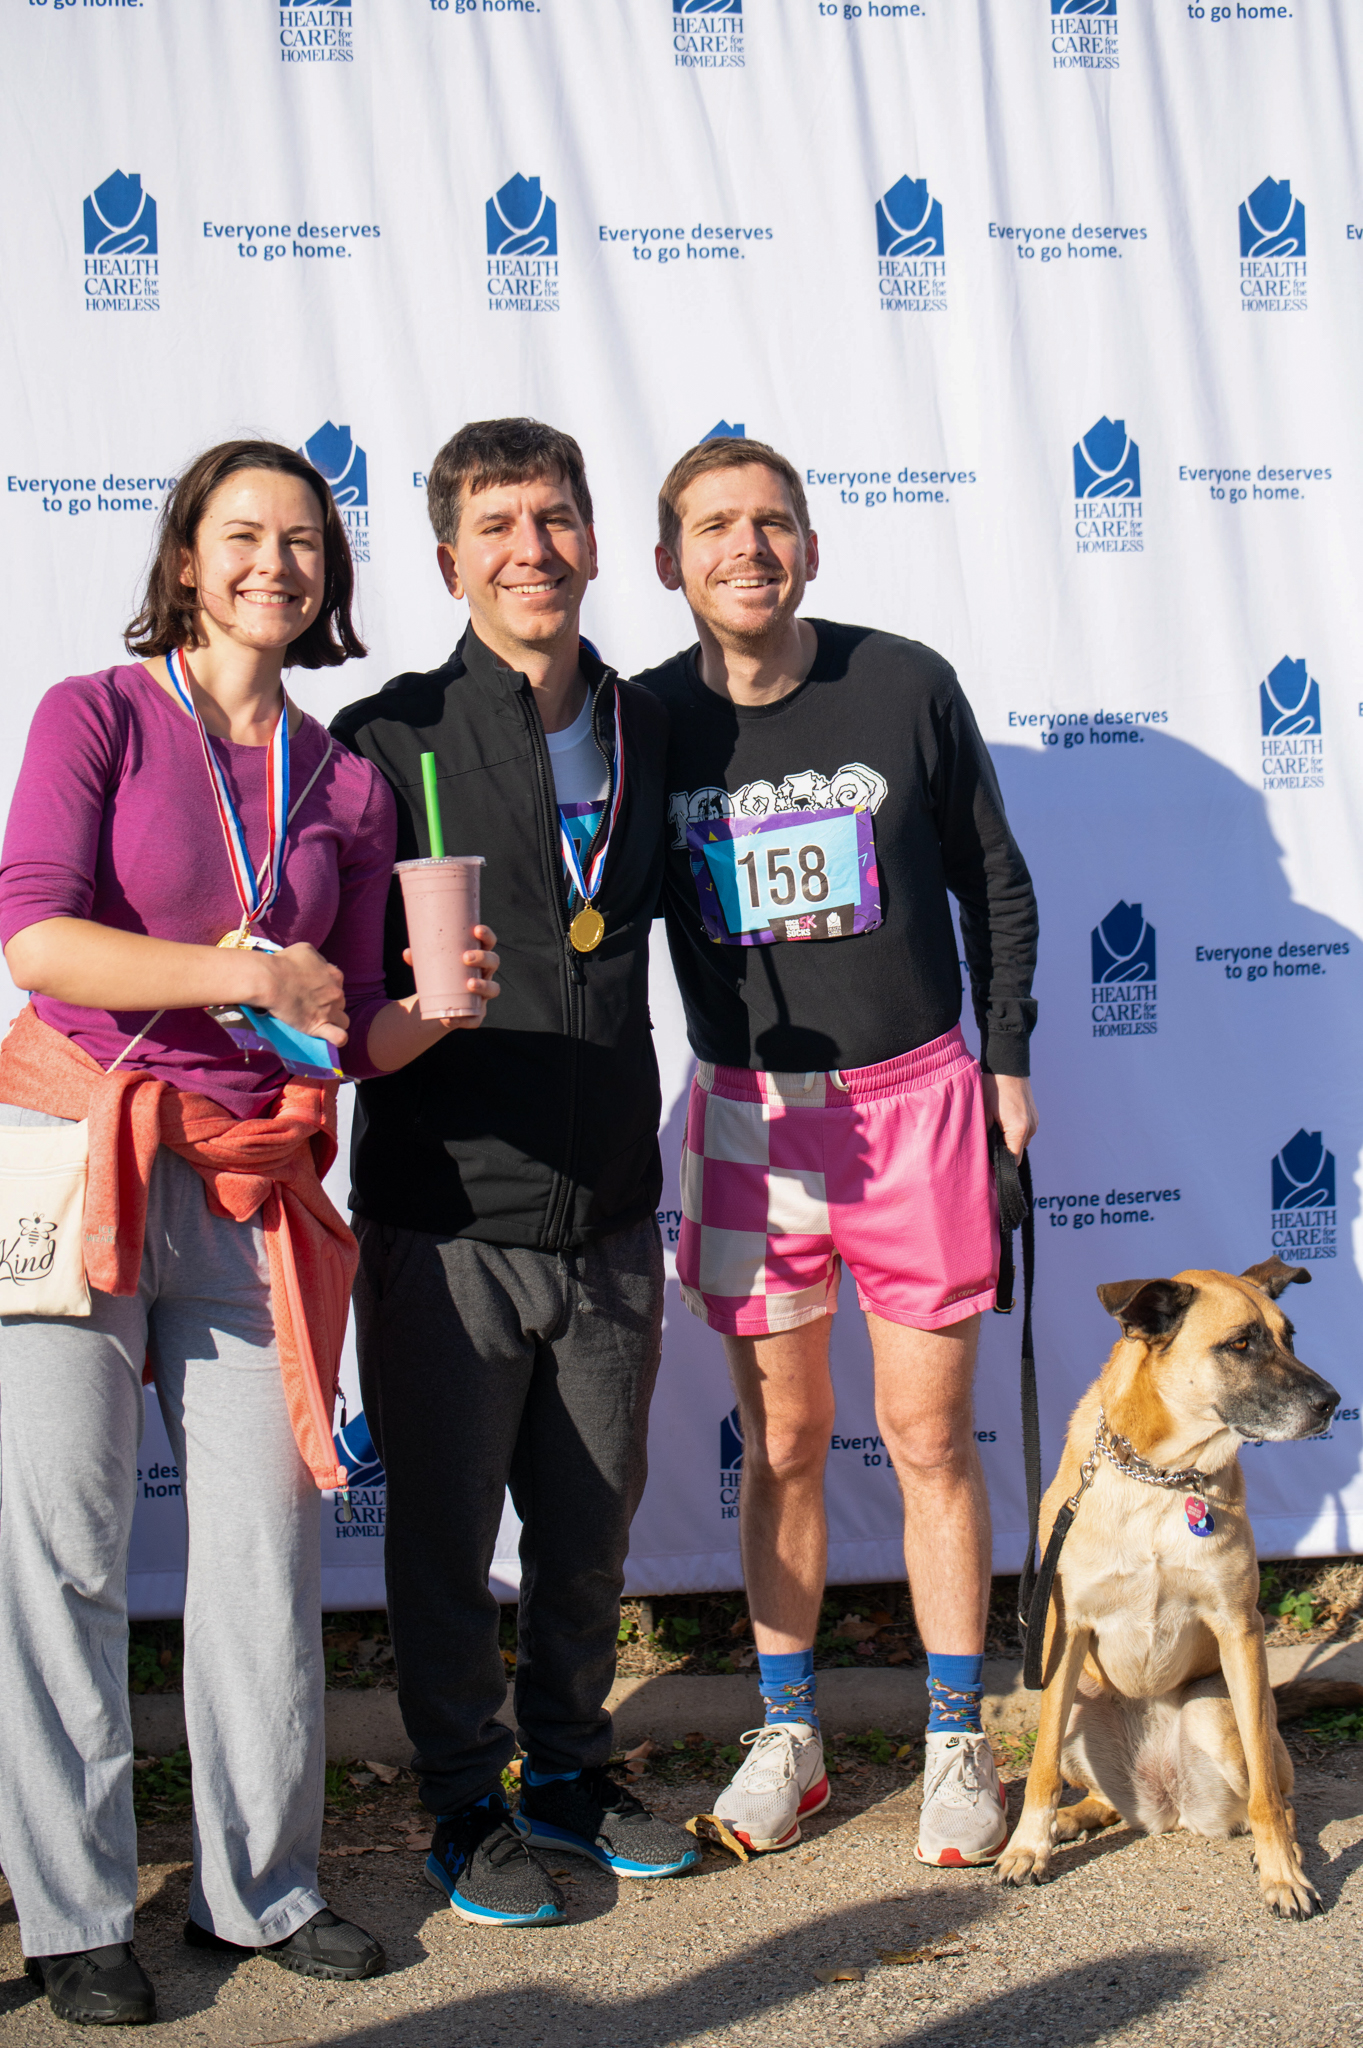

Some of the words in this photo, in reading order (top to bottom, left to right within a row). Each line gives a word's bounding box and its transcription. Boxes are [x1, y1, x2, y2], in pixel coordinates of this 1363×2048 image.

[430, 0, 449, 10] to
[455, 0, 477, 14] go
[483, 0, 540, 12] home.
[819, 2, 837, 16] to
[844, 4, 862, 20] go
[869, 1, 925, 17] home.
[1188, 5, 1205, 18] to
[1211, 7, 1231, 22] go
[1237, 3, 1292, 19] home.
[280, 11, 351, 27] HEALTH
[673, 17, 743, 33] HEALTH
[1051, 19, 1117, 35] HEALTH
[280, 29, 336, 46] CARE
[338, 29, 352, 39] for
[338, 37, 352, 47] the
[730, 35, 744, 45] for
[1105, 37, 1118, 46] for
[674, 35, 727, 52] CARE
[730, 43, 744, 53] the
[1052, 37, 1103, 53] CARE
[1105, 45, 1118, 54] the
[281, 49, 353, 61] HOMELESS
[675, 54, 745, 67] HOMELESS
[1053, 56, 1119, 69] HOMELESS
[204, 222, 291, 241] Everyone
[297, 221, 380, 238] deserves
[599, 226, 684, 244] Everyone
[691, 223, 773, 239] deserves
[989, 223, 1065, 243] Everyone
[1072, 223, 1147, 239] deserves
[238, 243, 257, 257] to
[264, 245, 286, 261] go
[293, 241, 351, 258] home.
[633, 246, 651, 260] to
[658, 248, 680, 263] go
[687, 243, 744, 259] home.
[1017, 245, 1035, 258] to
[1041, 247, 1061, 262] go
[1068, 242, 1122, 258] home.
[85, 259, 158, 275] HEALTH
[487, 260, 558, 276] HEALTH
[878, 261, 945, 277] HEALTH
[1240, 262, 1306, 277] HEALTH
[85, 278, 141, 295] CARE
[144, 277, 159, 287] for
[144, 285, 159, 295] the
[488, 279, 542, 296] CARE
[545, 279, 559, 288] for
[879, 279, 930, 296] CARE
[932, 279, 946, 288] for
[1240, 280, 1291, 296] CARE
[1293, 279, 1307, 288] for
[545, 287, 559, 296] the
[932, 287, 946, 296] the
[1293, 287, 1307, 296] the
[86, 299, 160, 310] HOMELESS
[489, 298, 559, 311] HOMELESS
[881, 298, 947, 311] HOMELESS
[1242, 299, 1307, 311] HOMELESS
[807, 470, 891, 488] Everyone
[898, 467, 976, 483] deserves
[1179, 466, 1251, 484] Everyone
[1257, 465, 1332, 481] deserves
[8, 476, 96, 495] Everyone
[840, 490, 859, 503] to
[865, 492, 886, 507] go
[893, 487, 949, 502] home.
[1210, 486, 1225, 500] to
[1230, 489, 1247, 504] go
[1253, 484, 1304, 500] home.
[42, 497, 62, 511] to
[69, 499, 91, 515] go
[98, 494, 158, 511] home.
[1075, 502, 1142, 518] HEALTH
[1075, 521, 1128, 538] CARE
[1130, 520, 1143, 529] for
[1130, 528, 1143, 537] the
[355, 529, 369, 539] for
[355, 537, 369, 547] the
[1077, 540, 1144, 553] HOMELESS
[1009, 712, 1088, 730] Everyone
[1094, 709, 1168, 725] deserves
[1040, 731, 1059, 745] to
[1064, 732, 1084, 749] go
[1090, 728, 1144, 744] home.
[1262, 739, 1322, 756] HEALTH
[1262, 757, 1309, 775] CARE
[1311, 756, 1323, 765] for
[1311, 764, 1323, 773] the
[1263, 776, 1324, 789] HOMELESS
[738, 845, 831, 909] 158
[799, 914, 817, 929] 5K
[1196, 946, 1273, 964] Everyone
[1278, 942, 1350, 958] deserves
[1225, 965, 1242, 979] to
[1247, 966, 1268, 982] go
[1274, 961, 1326, 977] home.
[1092, 985, 1157, 1004] HEALTH
[1092, 1003, 1142, 1023] CARE
[1143, 1002, 1157, 1012] for
[1143, 1010, 1157, 1020] the
[1093, 1022, 1157, 1037] HOMELESS
[1105, 1189, 1181, 1206] deserves
[1050, 1213, 1067, 1227] to
[1073, 1214, 1094, 1229] go
[1101, 1209, 1154, 1224] home.
[1272, 1210, 1336, 1229] HEALTH
[86, 1235, 113, 1244] WEAR
[1272, 1229, 1321, 1248] CARE
[1322, 1227, 1336, 1237] for
[1322, 1235, 1336, 1245] the
[0, 1237, 56, 1281] Kind
[831, 1435, 885, 1451] Every
[863, 1454, 881, 1467] to
[144, 1482, 182, 1499] hom
[334, 1490, 386, 1506] HEAL
[336, 1525, 386, 1538] HOMEL
